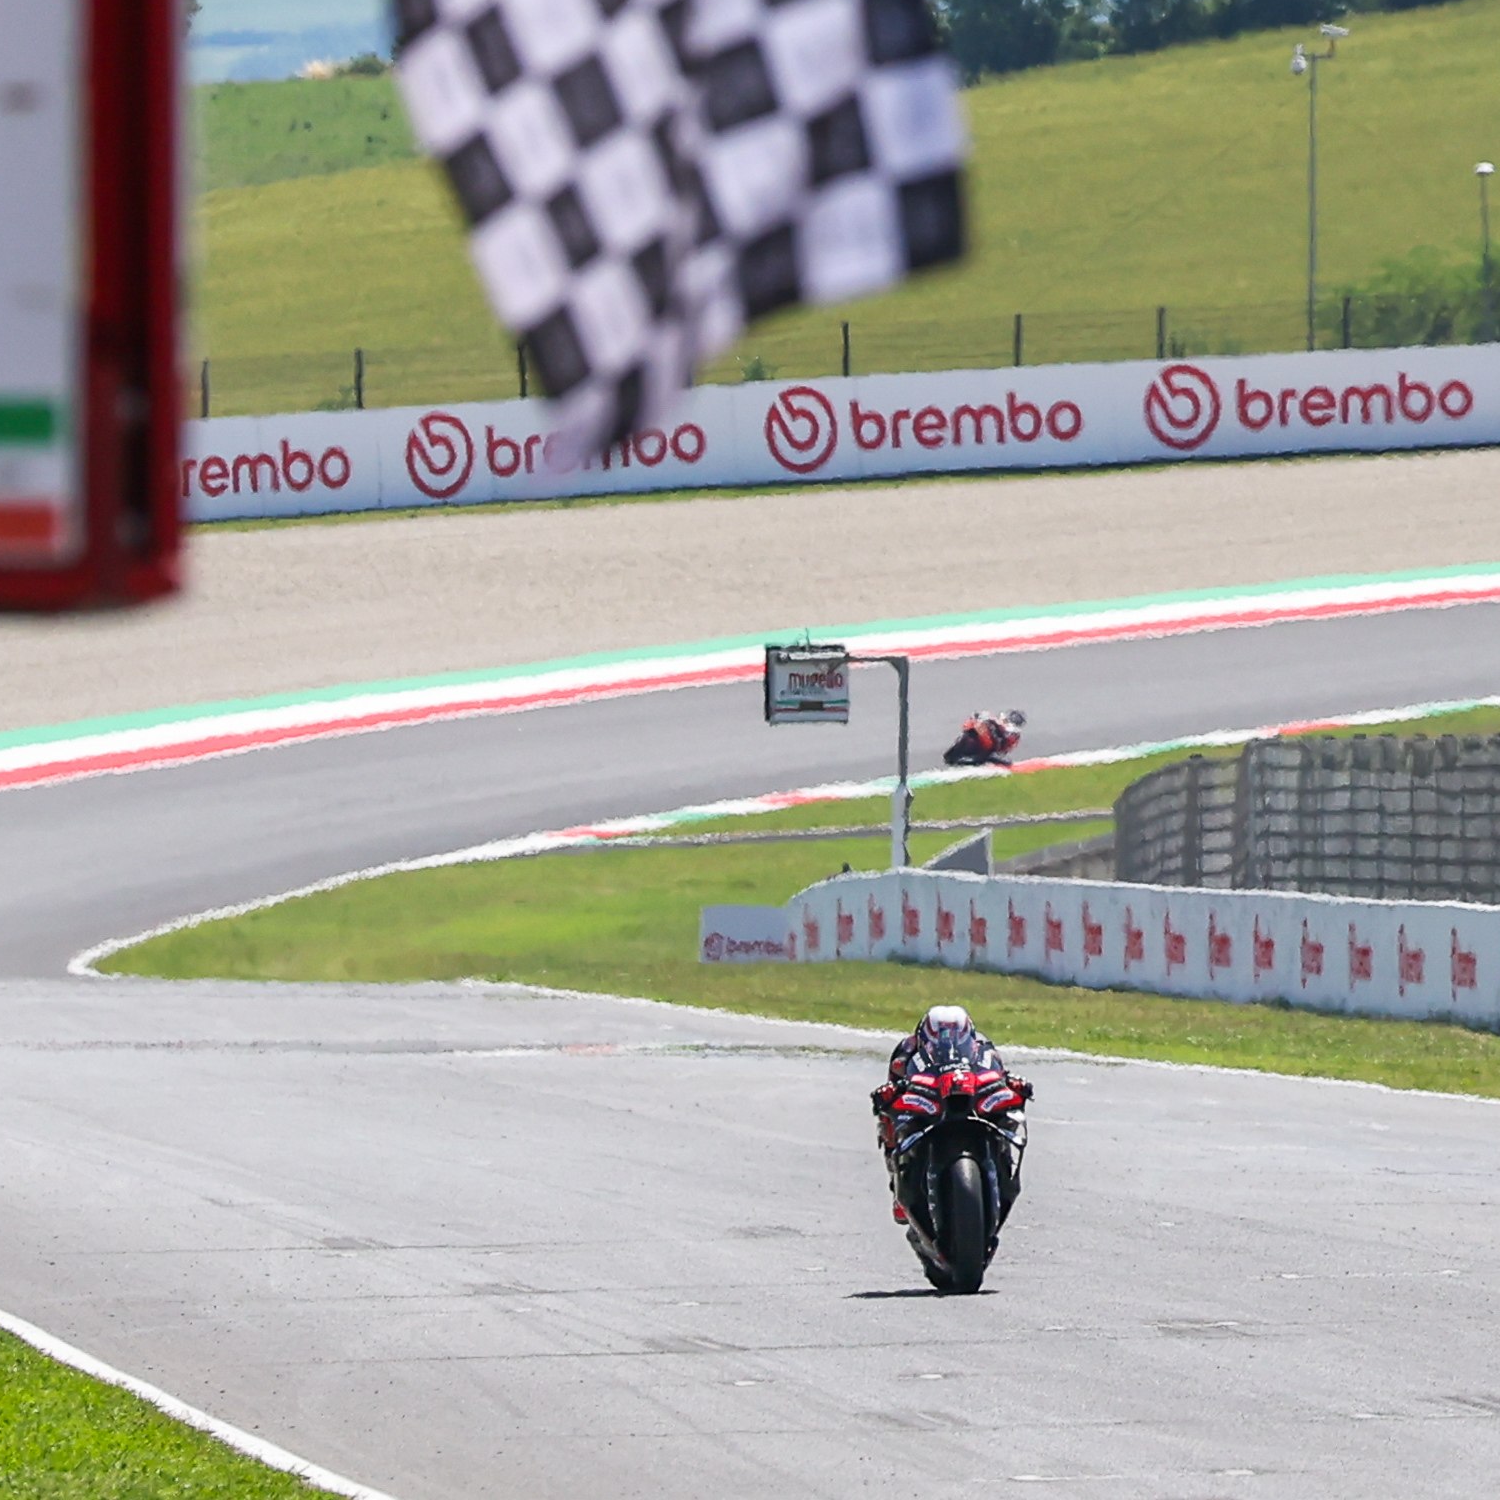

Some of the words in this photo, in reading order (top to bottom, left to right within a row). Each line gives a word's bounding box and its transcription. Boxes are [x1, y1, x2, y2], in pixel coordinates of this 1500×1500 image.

[850, 392, 1082, 450] brembo
[1237, 372, 1473, 430] brembo
[181, 439, 351, 497] rembo
[485, 422, 706, 477] brbo
